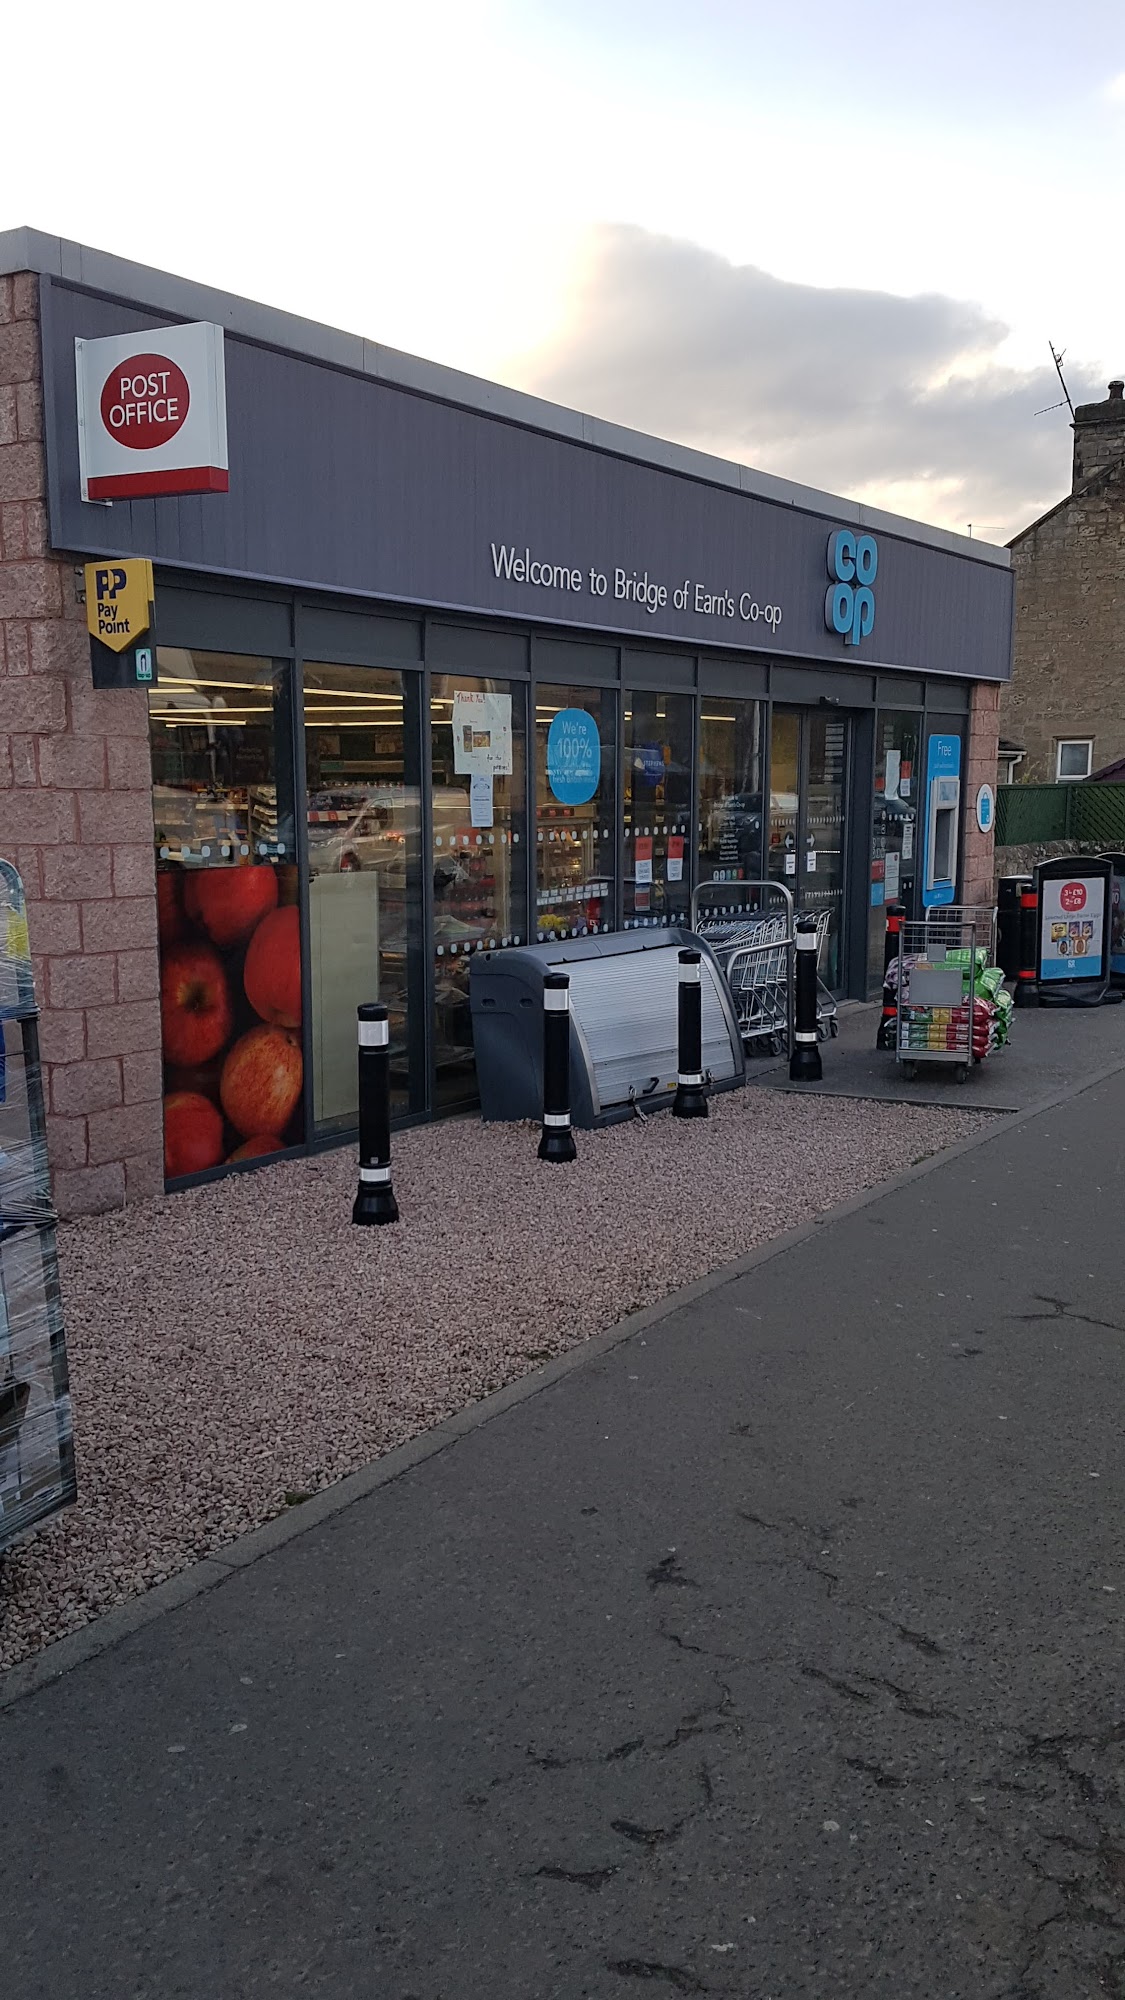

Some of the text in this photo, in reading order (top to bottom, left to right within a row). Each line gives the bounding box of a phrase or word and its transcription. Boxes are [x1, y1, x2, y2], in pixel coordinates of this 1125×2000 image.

[120, 371, 171, 400] POST
[109, 398, 179, 428] OFFICE
[490, 542, 782, 634] Welcome to Bridge of Earn's Co-op
[97, 602, 118, 621] Pay
[98, 618, 130, 634] Point
[562, 721, 587, 735] We're
[557, 738, 593, 759] 100%
[937, 740, 952, 757] Free
[1064, 889, 1069, 897] 3
